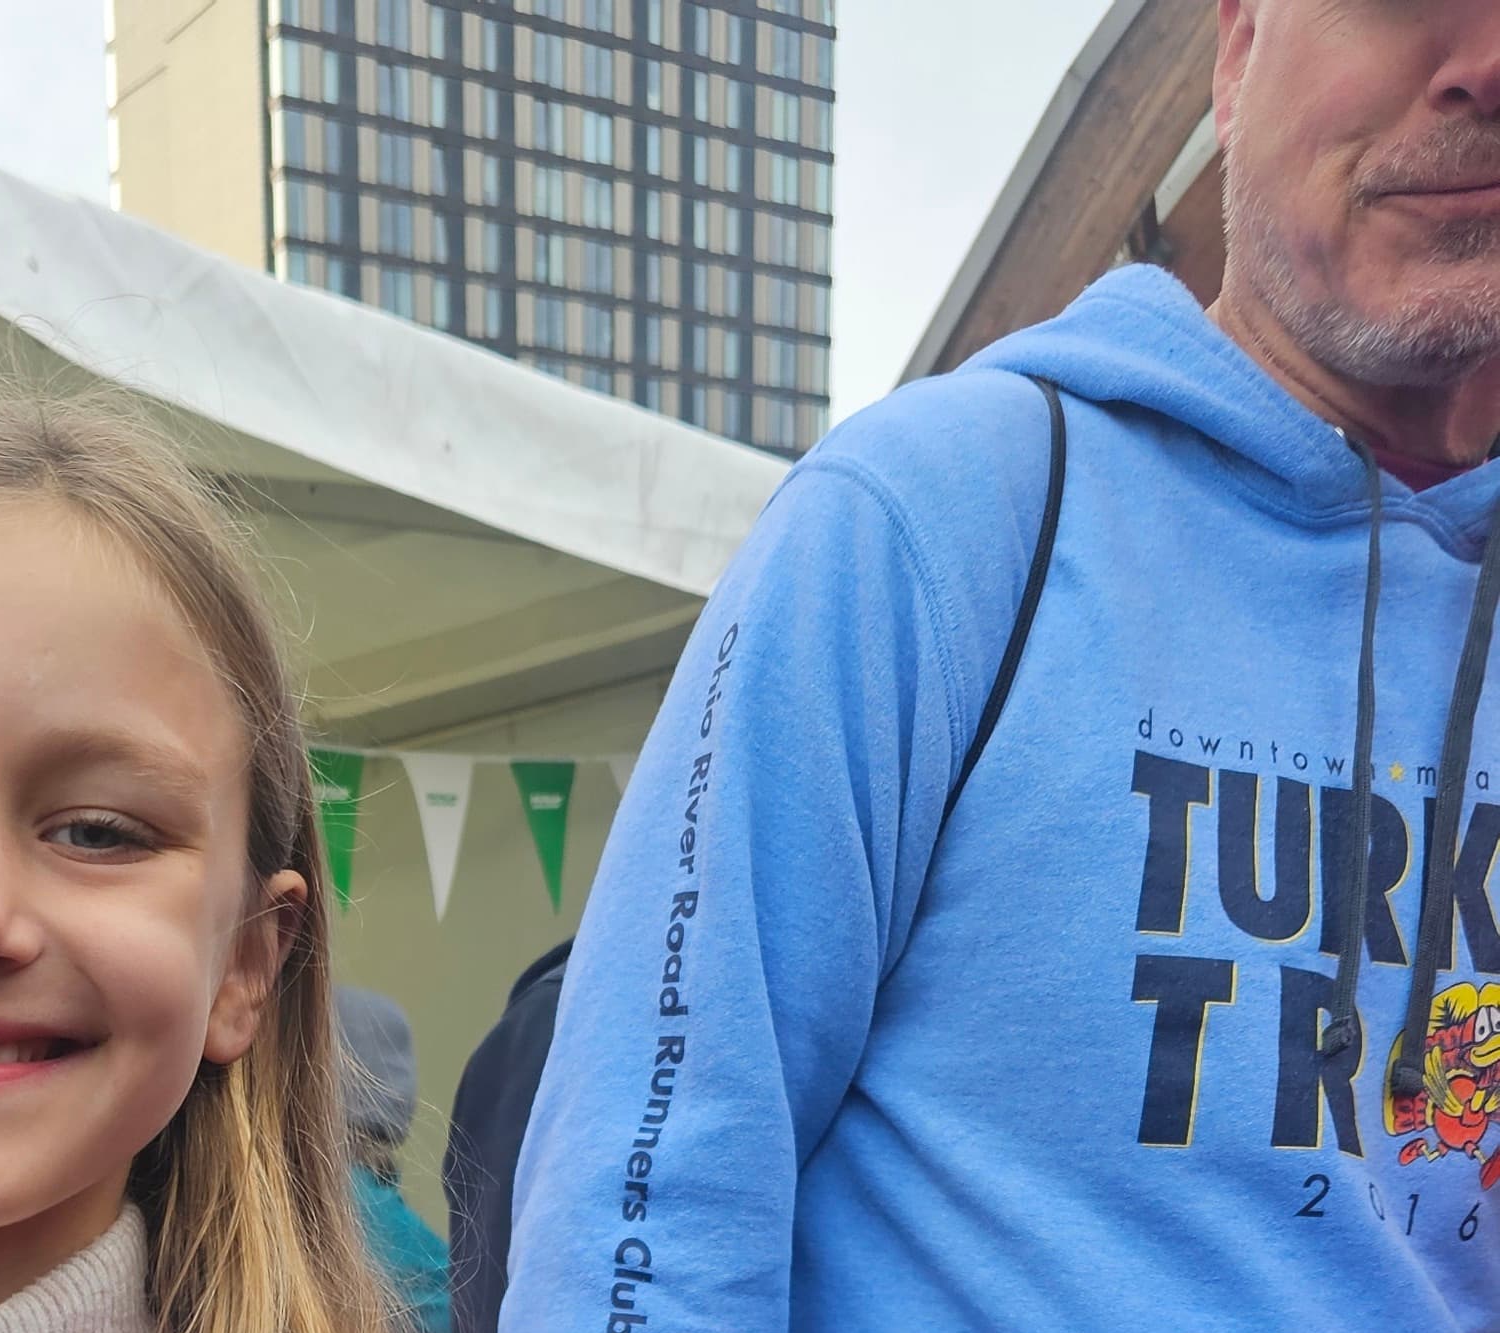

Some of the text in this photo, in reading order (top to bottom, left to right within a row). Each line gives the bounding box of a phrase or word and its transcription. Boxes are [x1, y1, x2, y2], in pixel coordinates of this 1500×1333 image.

[700, 622, 739, 739] Ohio
[678, 751, 713, 875] River
[659, 890, 700, 1017] Road
[621, 1035, 686, 1223] Runners
[1293, 1172, 1481, 1242] 2016
